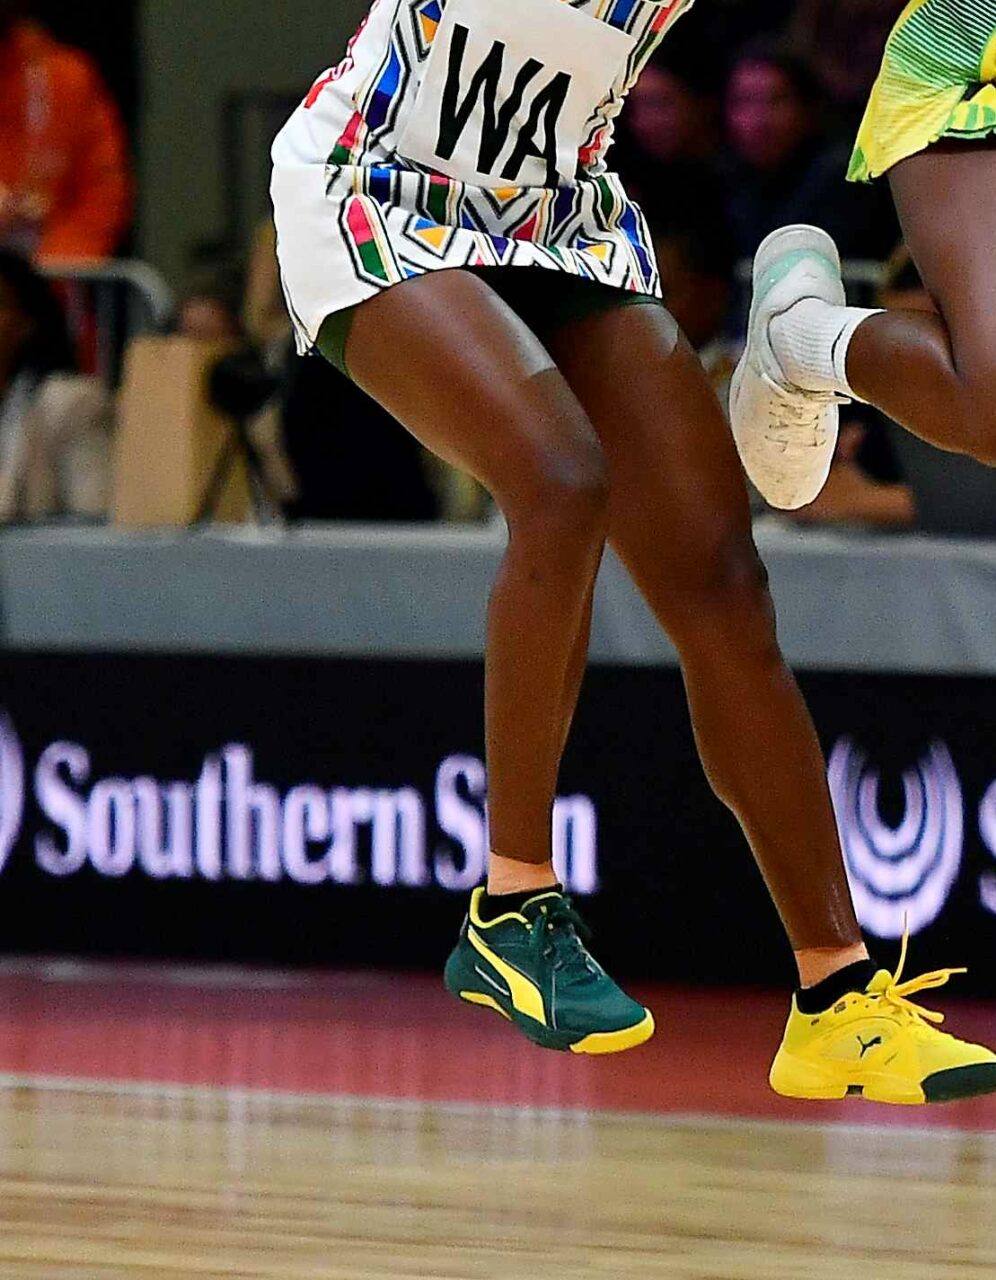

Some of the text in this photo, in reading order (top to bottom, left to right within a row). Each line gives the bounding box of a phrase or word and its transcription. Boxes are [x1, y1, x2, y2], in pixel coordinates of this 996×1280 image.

[434, 22, 572, 189] WA
[35, 740, 598, 897] Southern Sn
